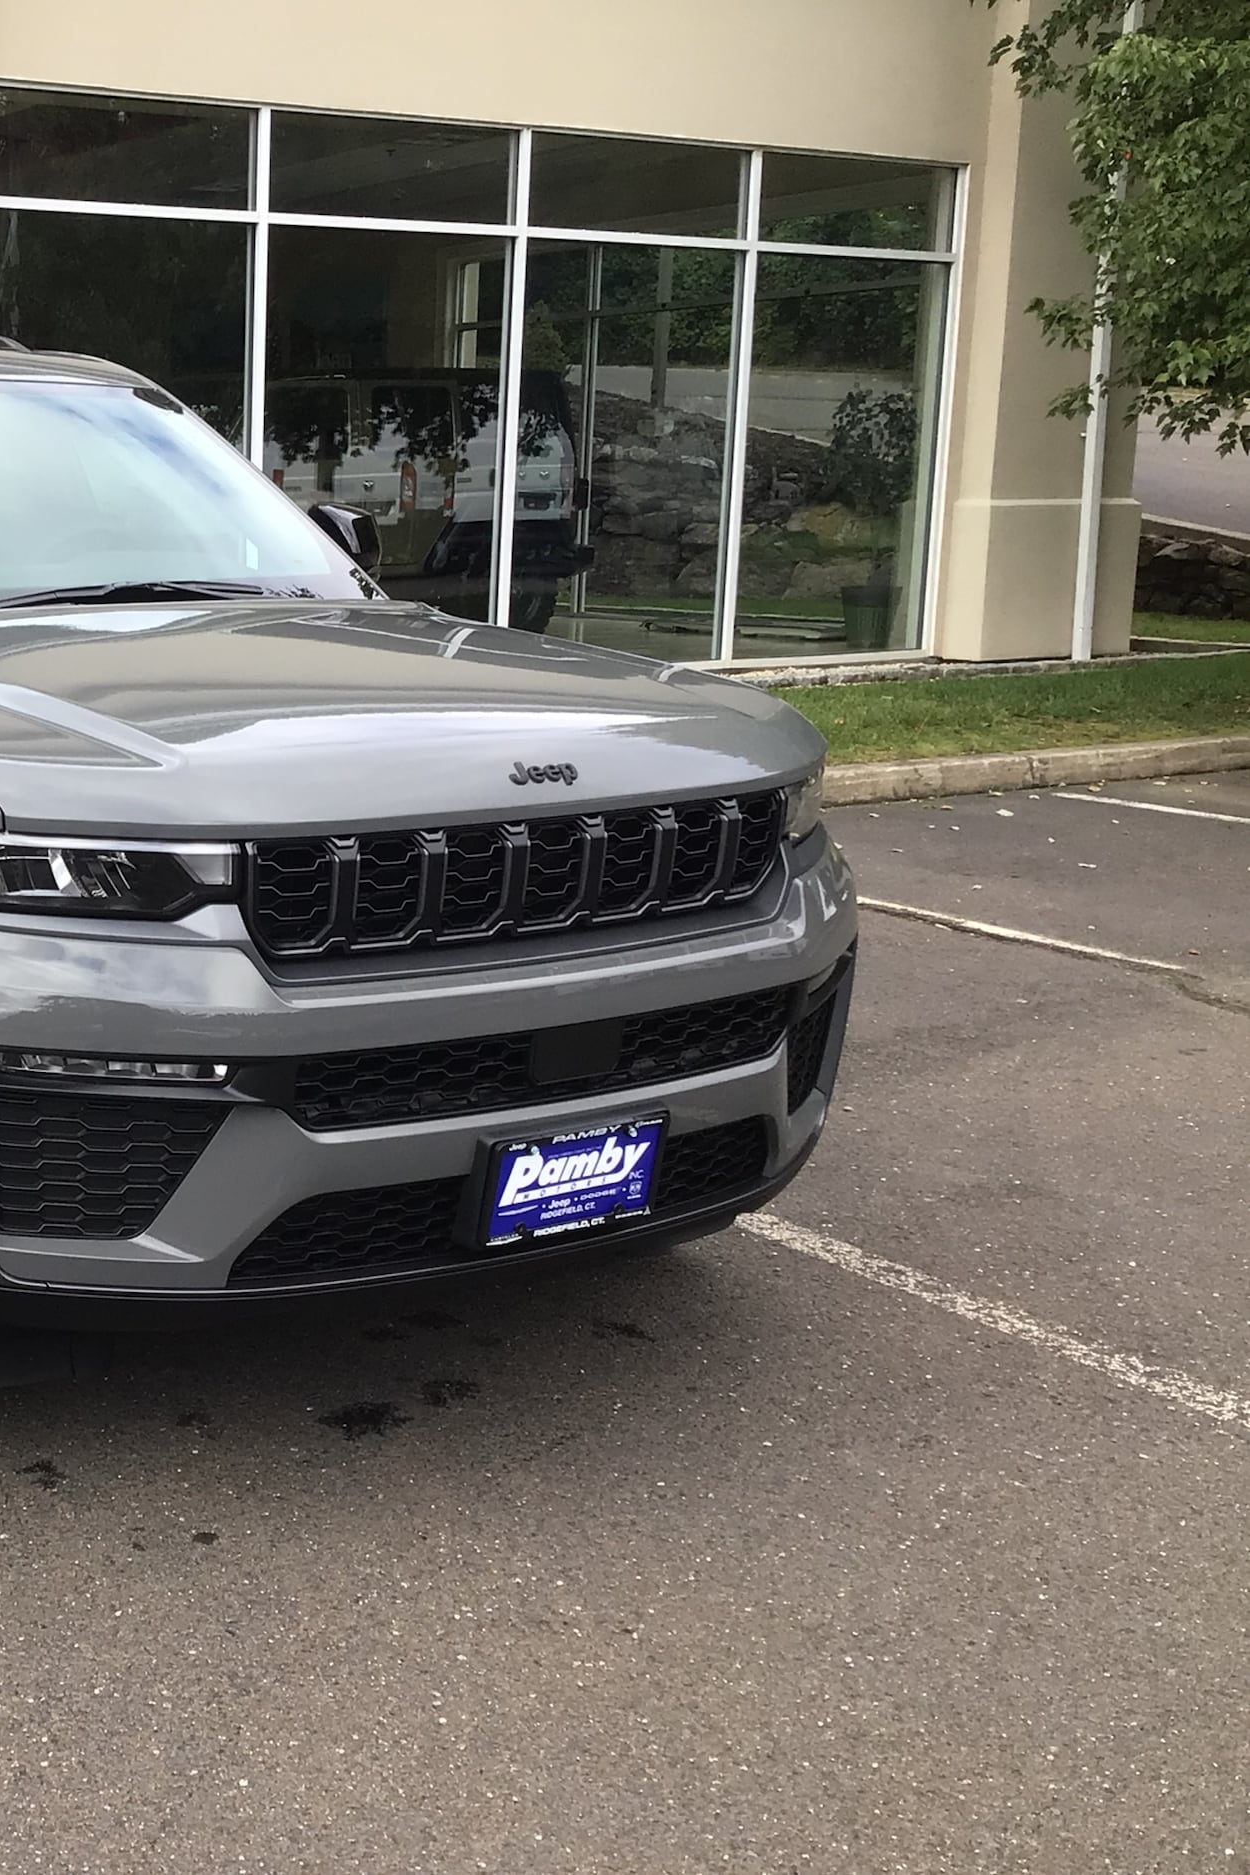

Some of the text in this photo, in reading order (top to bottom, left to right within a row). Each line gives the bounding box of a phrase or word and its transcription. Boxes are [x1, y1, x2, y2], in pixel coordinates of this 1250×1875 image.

[508, 761, 579, 786] Jeep
[551, 1124, 622, 1144] PAMBY
[498, 1136, 651, 1207] Pamby
[548, 1198, 571, 1210] Jeep
[533, 1216, 606, 1238] RIDGEFIELD, CT.
